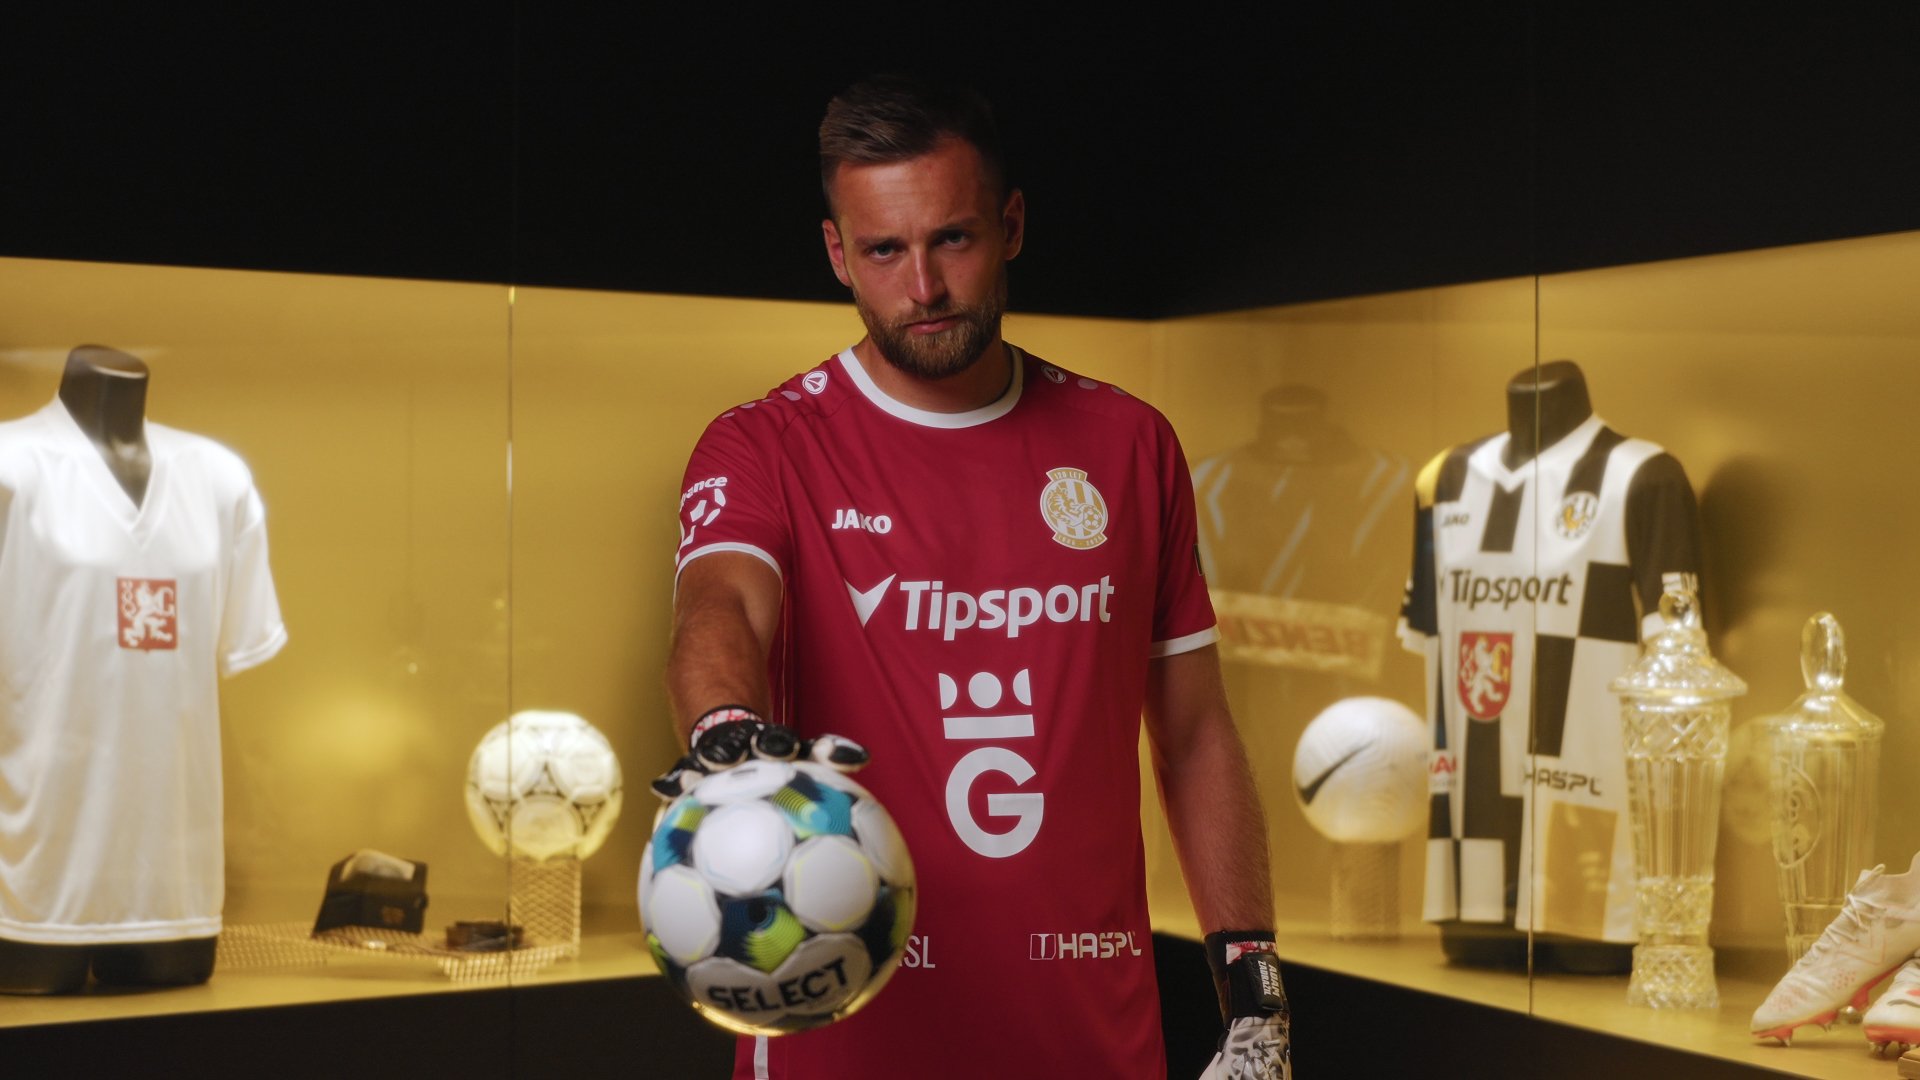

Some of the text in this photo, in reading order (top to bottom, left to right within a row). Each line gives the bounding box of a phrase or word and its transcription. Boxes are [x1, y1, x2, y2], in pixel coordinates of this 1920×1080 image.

[831, 509, 892, 534] JAKO
[899, 575, 1115, 641] Tipsport
[1450, 568, 1573, 611] Tipsport
[898, 934, 936, 969] SL
[707, 957, 848, 1013] SELECT
